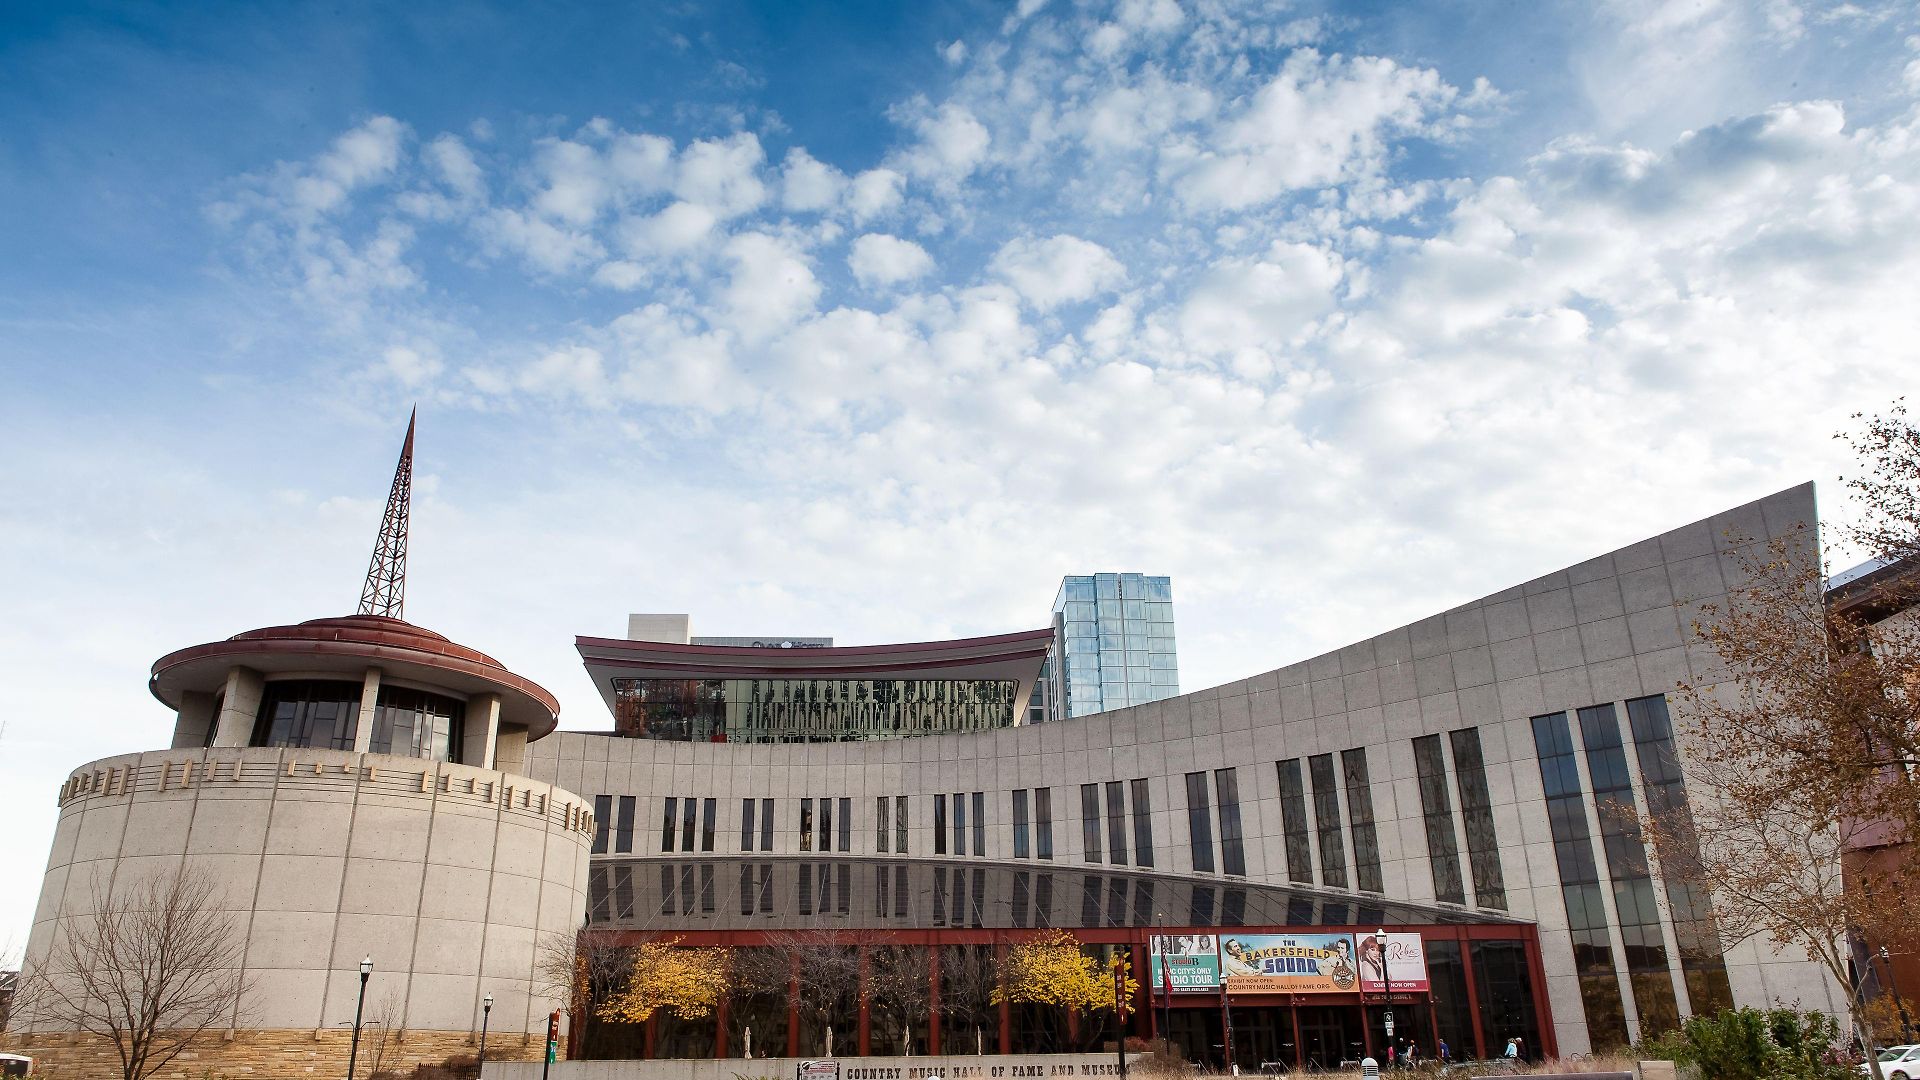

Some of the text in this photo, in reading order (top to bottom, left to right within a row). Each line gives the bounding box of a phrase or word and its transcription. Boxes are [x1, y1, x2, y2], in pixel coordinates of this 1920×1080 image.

[1245, 948, 1330, 961] BAKERSFIELD
[1264, 957, 1317, 973] SOUND
[1158, 976, 1213, 984] SUDIO TOUR
[847, 1068, 902, 1080] COUNTRY
[909, 1067, 946, 1079] MUSIC
[953, 1067, 983, 1078] HALL
[991, 1067, 1005, 1077] OF
[1012, 1066, 1044, 1077] FAME
[1051, 1065, 1075, 1076] AND
